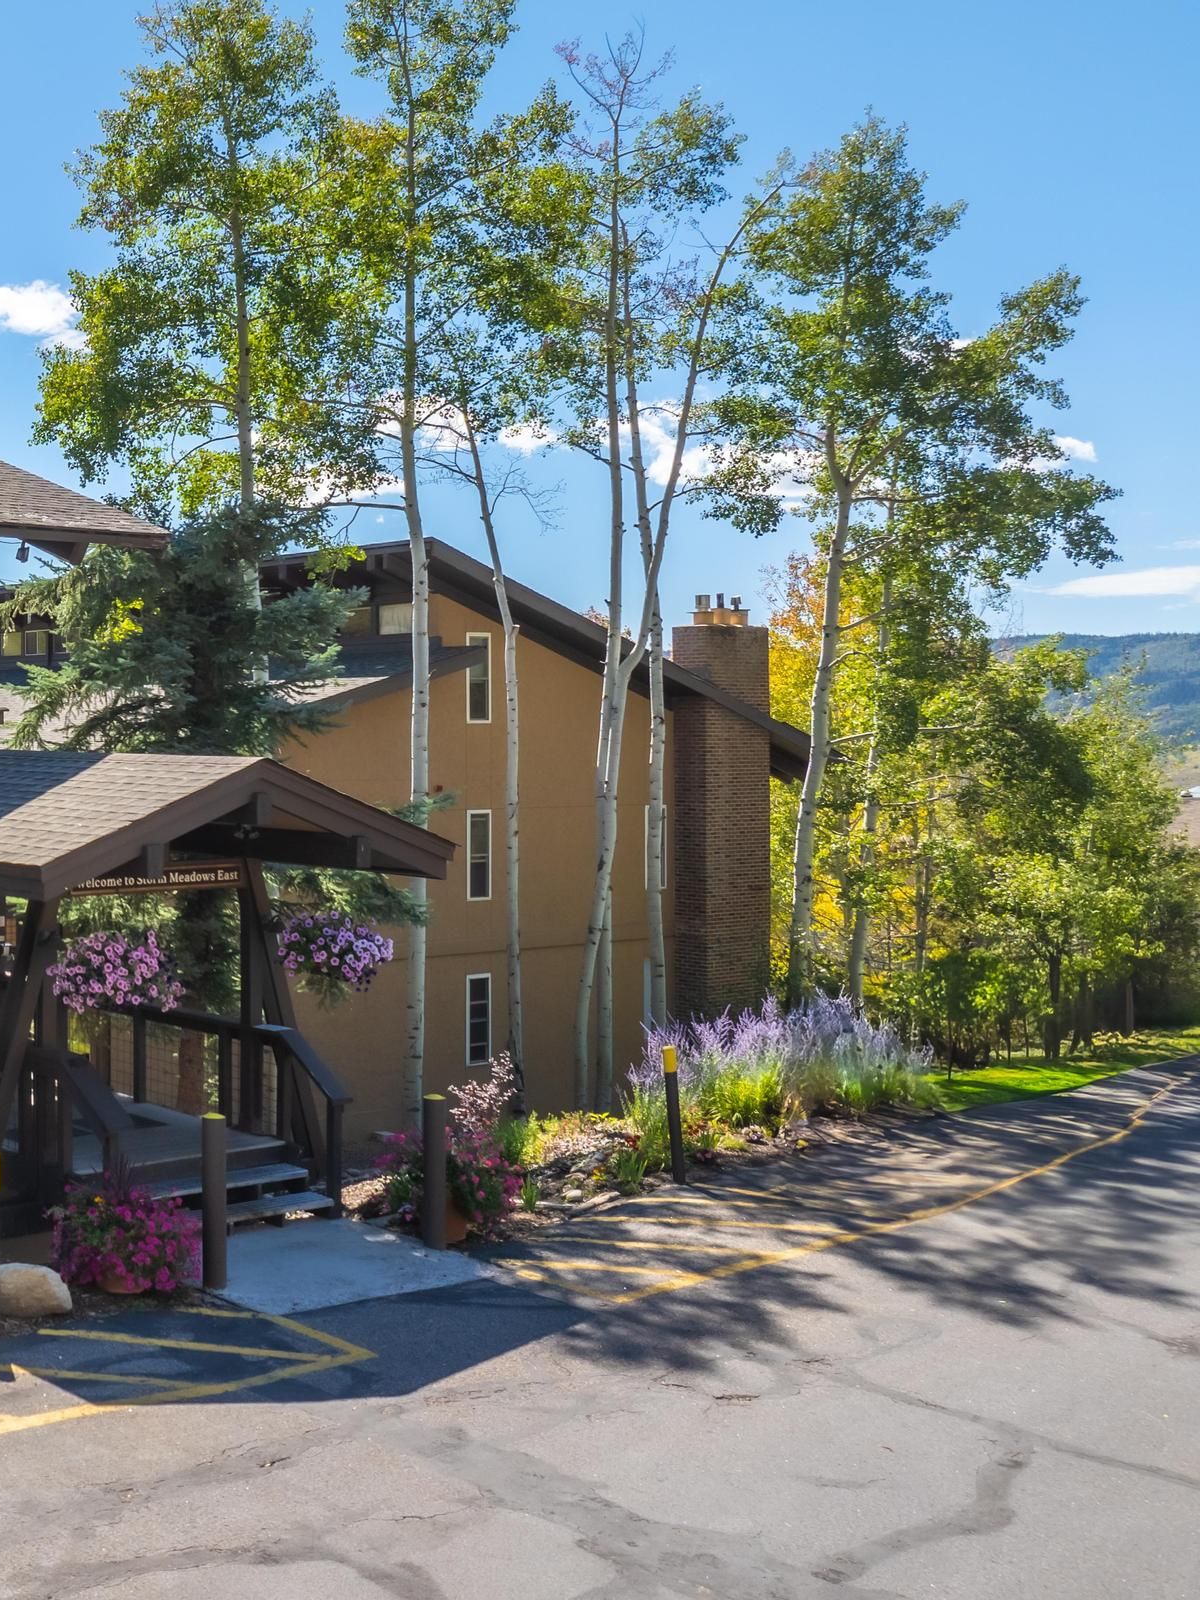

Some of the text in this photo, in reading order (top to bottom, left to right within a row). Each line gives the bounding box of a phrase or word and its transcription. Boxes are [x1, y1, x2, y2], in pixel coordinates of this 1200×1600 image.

[124, 876, 135, 886] to
[169, 871, 215, 883] Meadows
[217, 869, 238, 881] East
